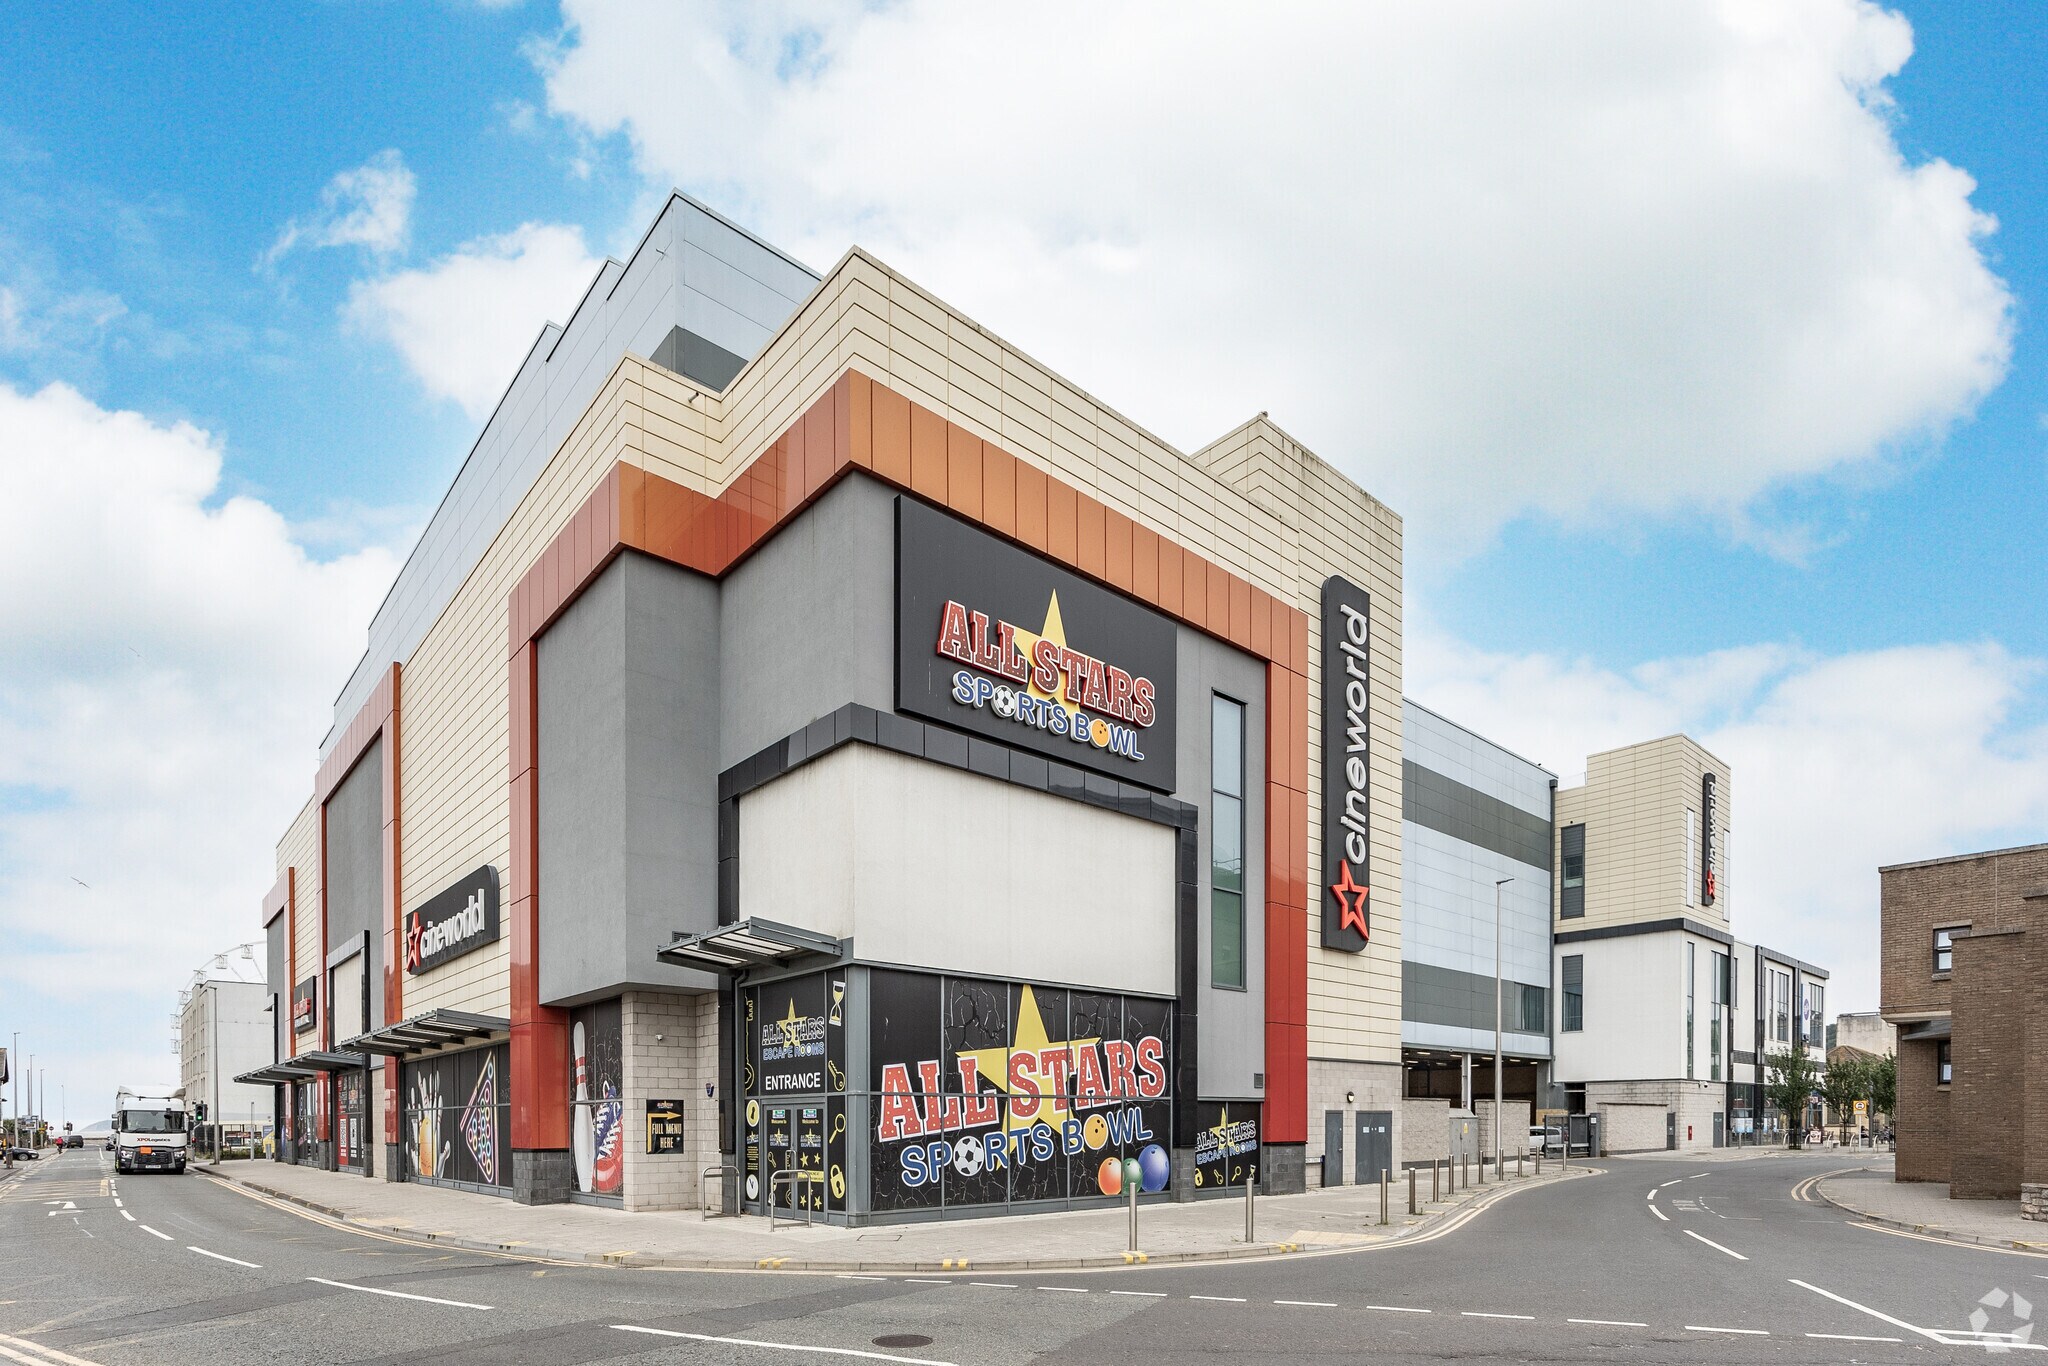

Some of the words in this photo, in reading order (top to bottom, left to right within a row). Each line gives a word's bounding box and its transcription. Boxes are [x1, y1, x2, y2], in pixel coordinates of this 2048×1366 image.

[937, 600, 1028, 684] ALL
[1032, 639, 1155, 728] STARS
[1339, 603, 1367, 865] cineworld
[420, 888, 485, 959] cineworld
[762, 1023, 784, 1046] ALL
[785, 1016, 825, 1042] STARS
[762, 1045, 793, 1061] ESCAPE
[794, 1041, 825, 1058] ROOMS
[765, 1072, 821, 1091] ENTRANCE
[878, 1055, 999, 1143] ALL
[1008, 1036, 1166, 1121] STARS
[652, 1123, 664, 1135] FULL
[665, 1123, 682, 1135] MENU
[660, 1137, 674, 1149] HERE
